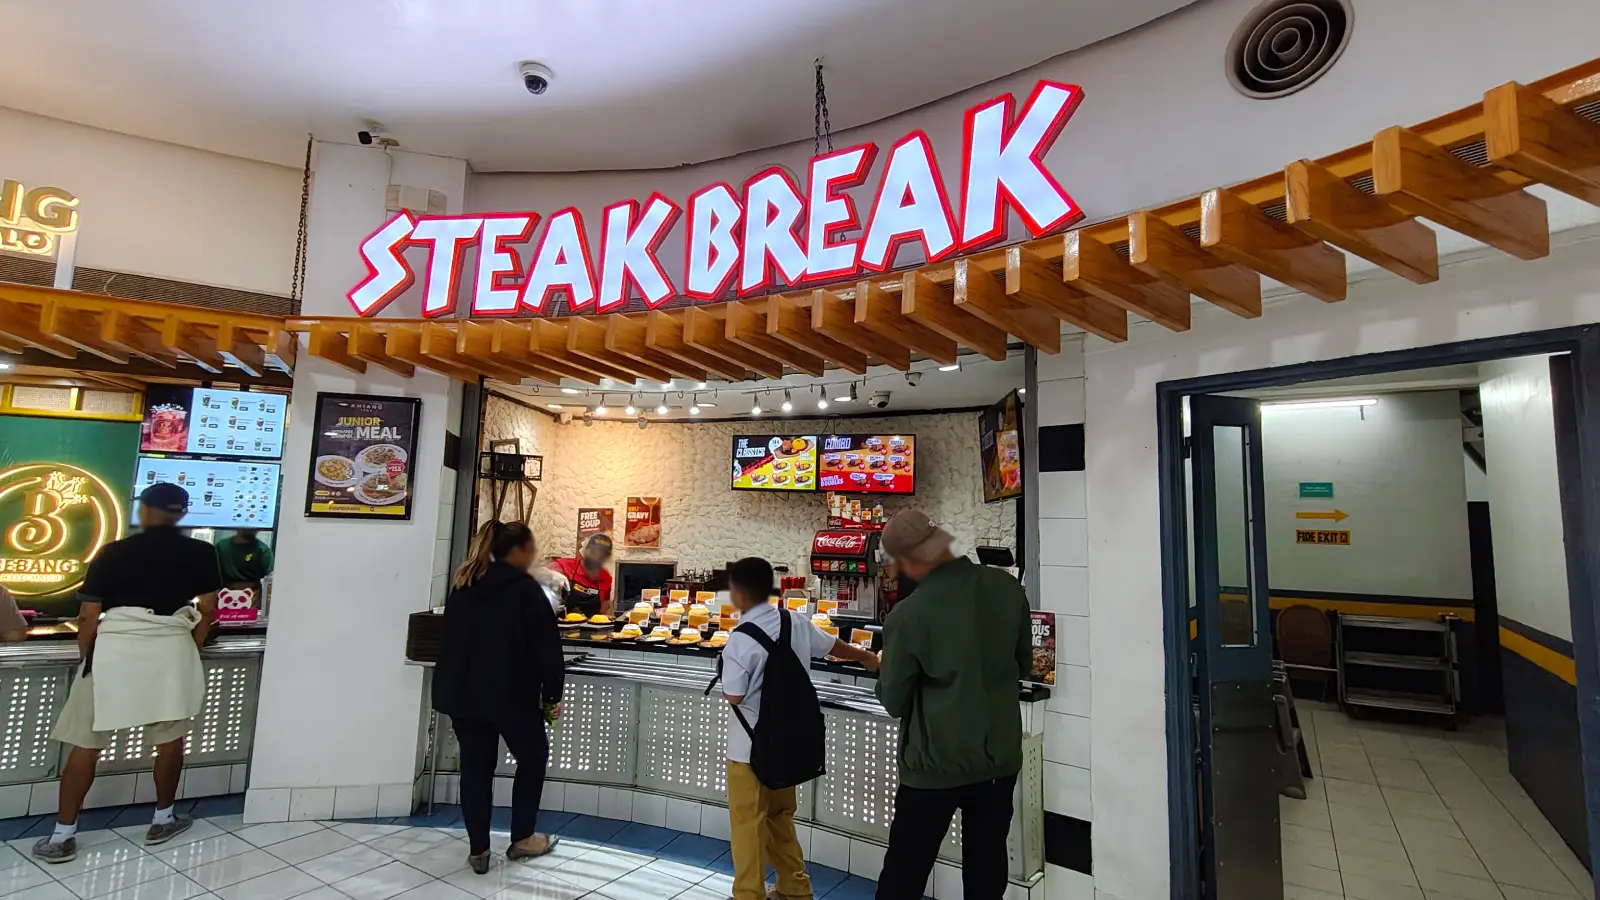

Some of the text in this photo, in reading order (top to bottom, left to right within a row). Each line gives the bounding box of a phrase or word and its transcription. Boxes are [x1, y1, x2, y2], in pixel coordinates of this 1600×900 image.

[346, 79, 1085, 317] STEAK BREAK
[0, 227, 53, 253] LO
[336, 416, 384, 427] JUNIOR
[356, 426, 402, 439] MEAL
[738, 439, 749, 448] THE
[824, 437, 851, 450] COMBO
[580, 511, 599, 520] FREE
[627, 511, 650, 519] GRAVY
[580, 519, 600, 529] SOUP
[817, 534, 859, 549] Coca-Cola
[1318, 531, 1338, 543] EXIT
[0, 558, 80, 574] EBANG
[1031, 624, 1051, 637] OUS
